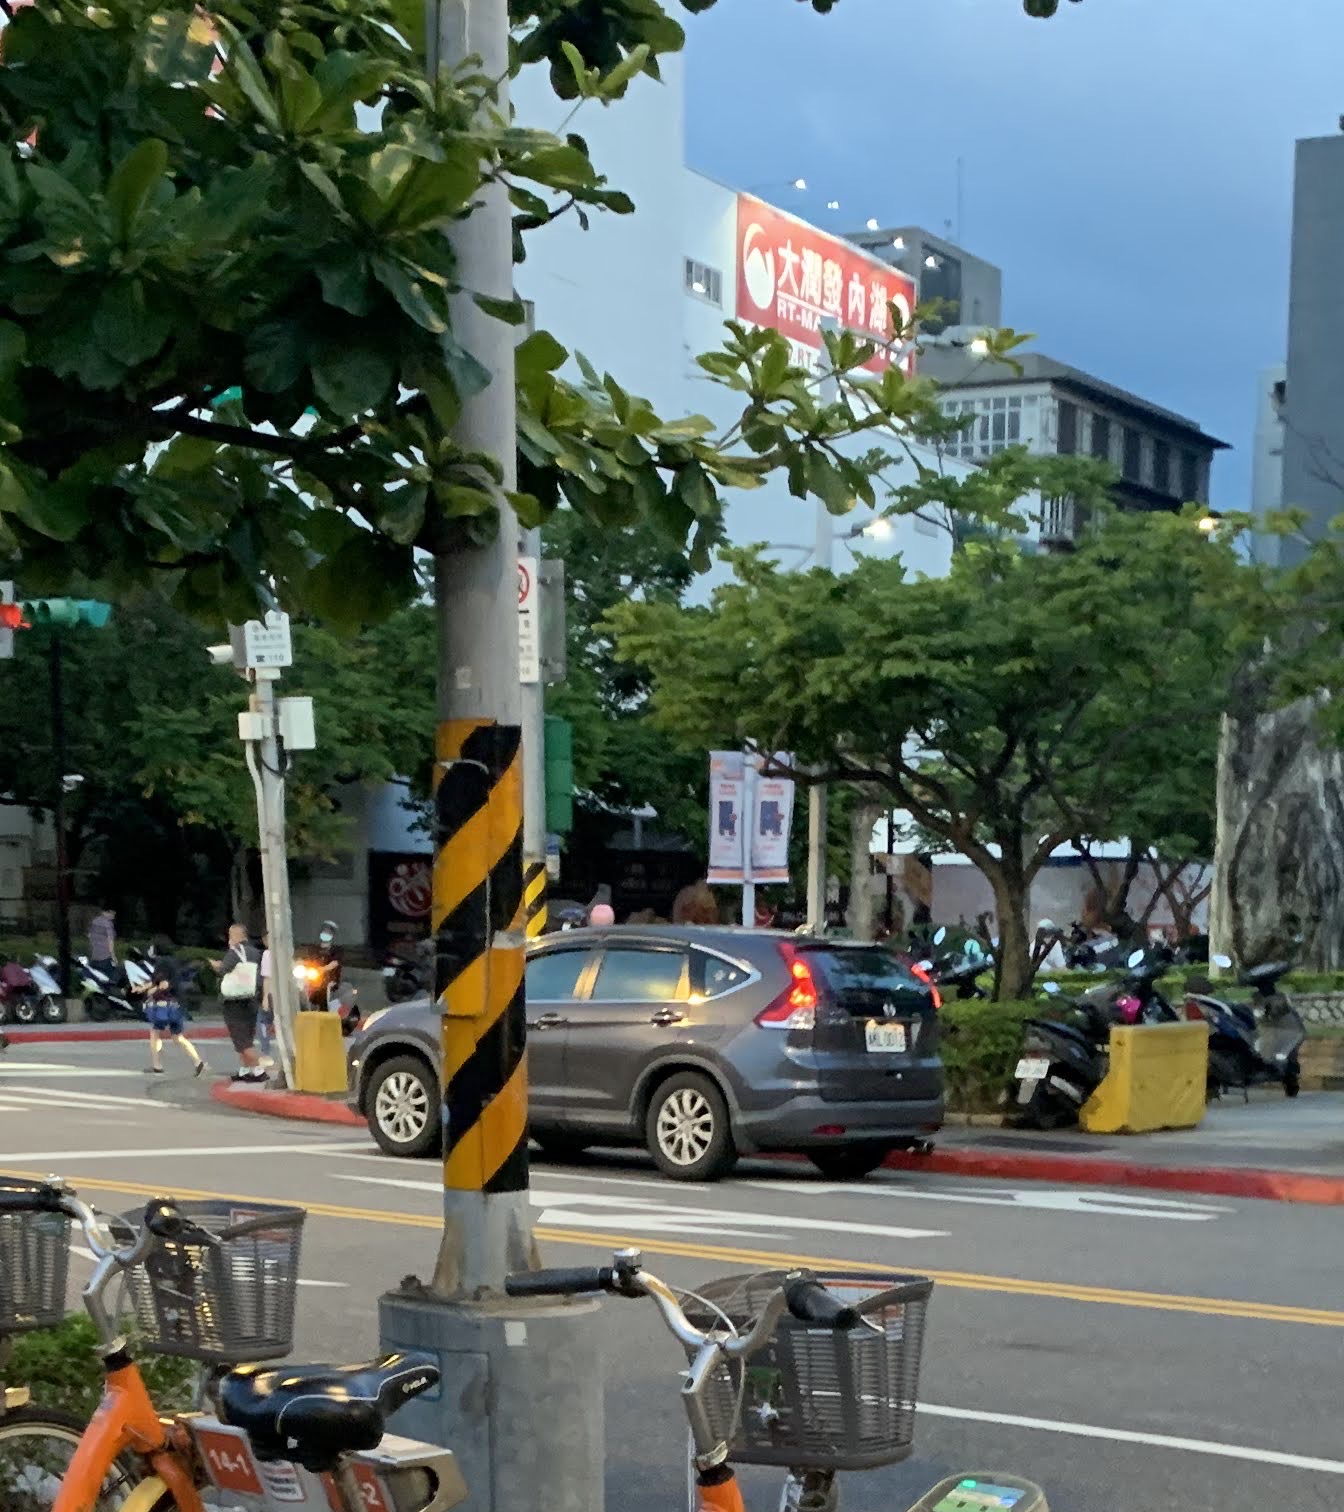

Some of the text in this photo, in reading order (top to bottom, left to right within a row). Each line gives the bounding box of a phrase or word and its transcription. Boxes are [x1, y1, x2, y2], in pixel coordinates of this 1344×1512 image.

[777, 239, 844, 314] 大潤發
[209, 1449, 251, 1476] 14-1
